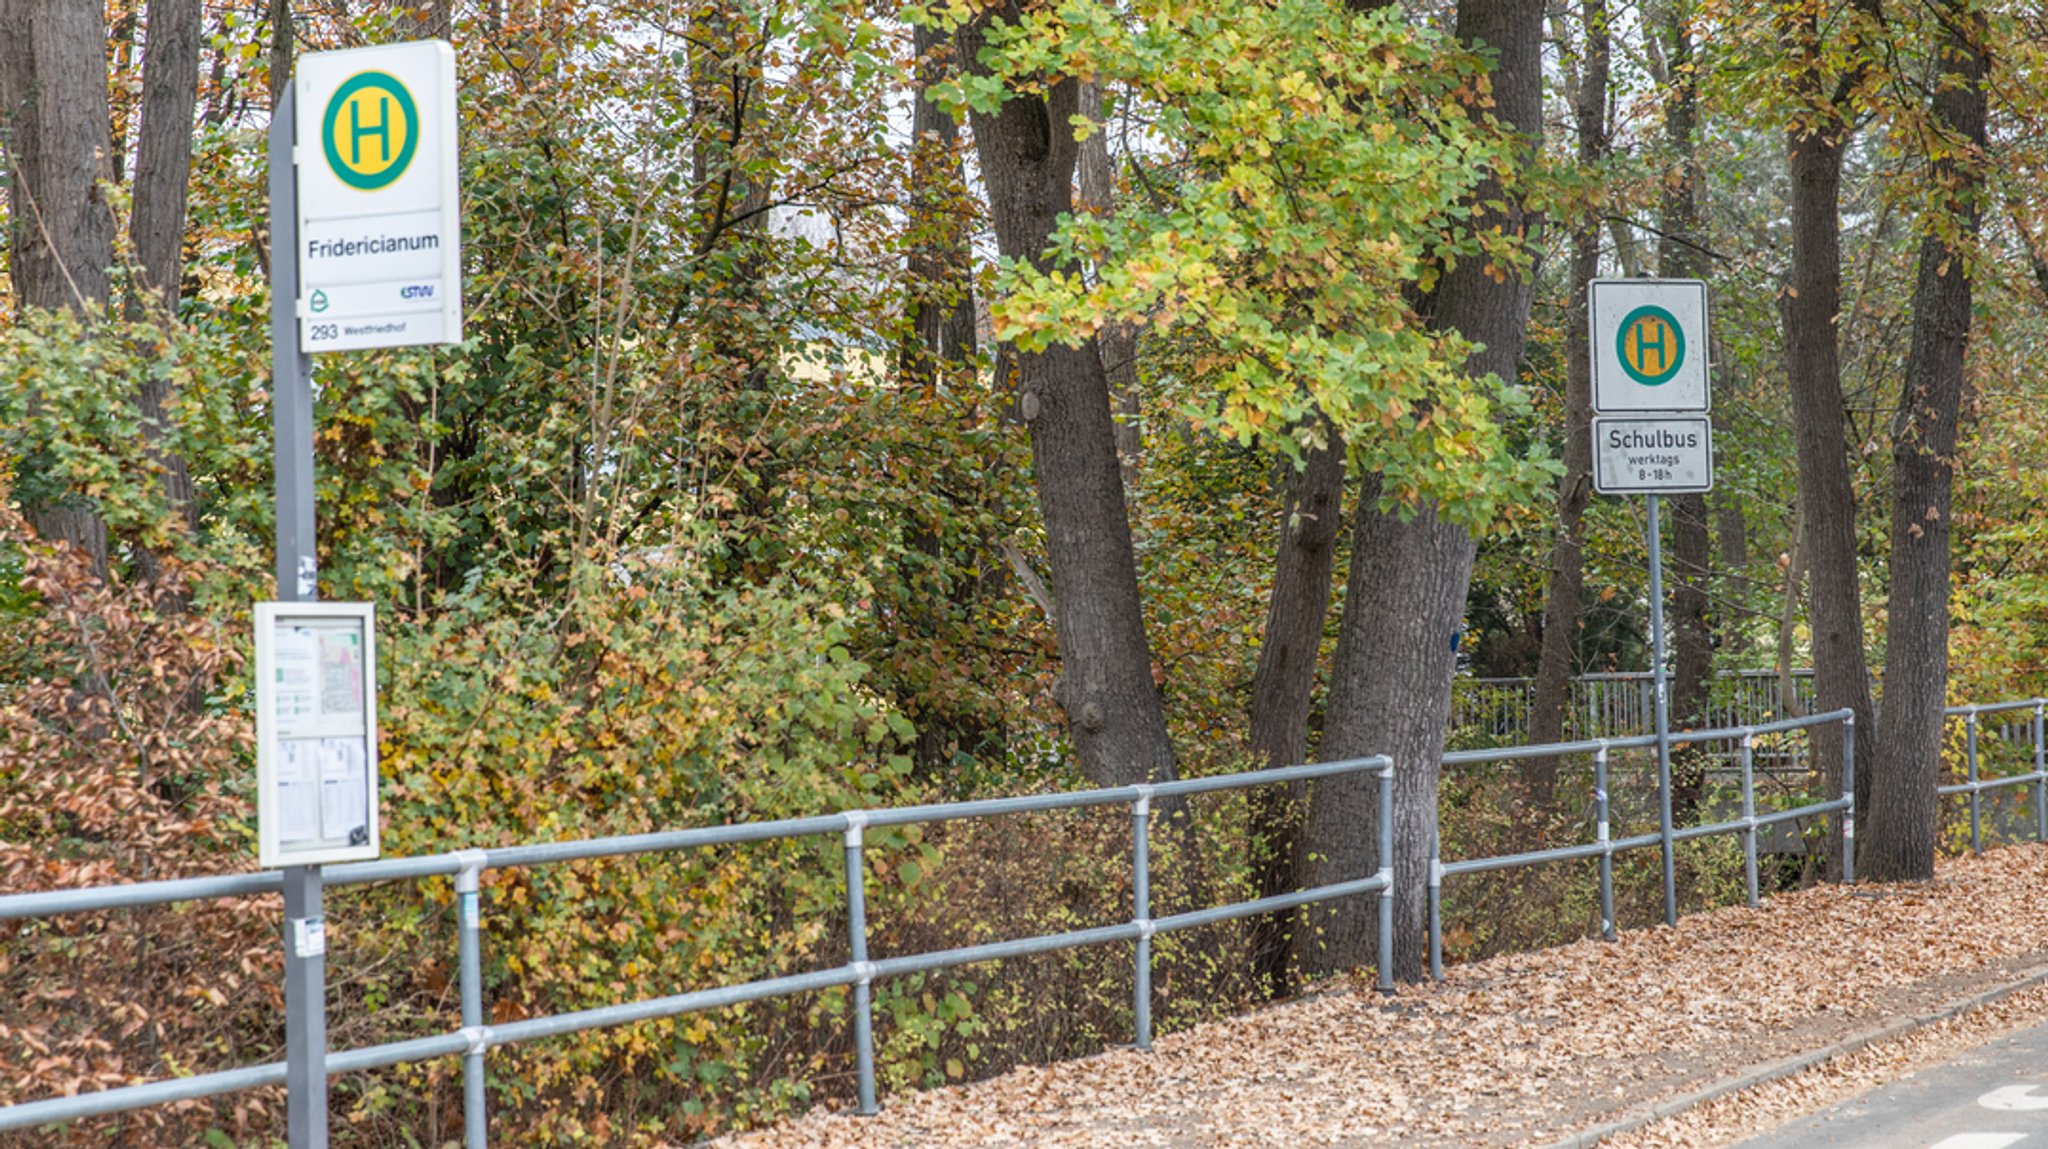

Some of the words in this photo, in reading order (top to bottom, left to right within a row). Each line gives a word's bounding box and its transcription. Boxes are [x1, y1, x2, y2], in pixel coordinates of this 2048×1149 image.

[350, 97, 390, 164] H
[308, 234, 439, 259] Fridericianum
[311, 323, 338, 340] 293
[344, 322, 406, 336] Westfriedhof
[1636, 323, 1665, 370] H
[1609, 429, 1697, 448] Schulbus
[1628, 453, 1680, 467] werktags
